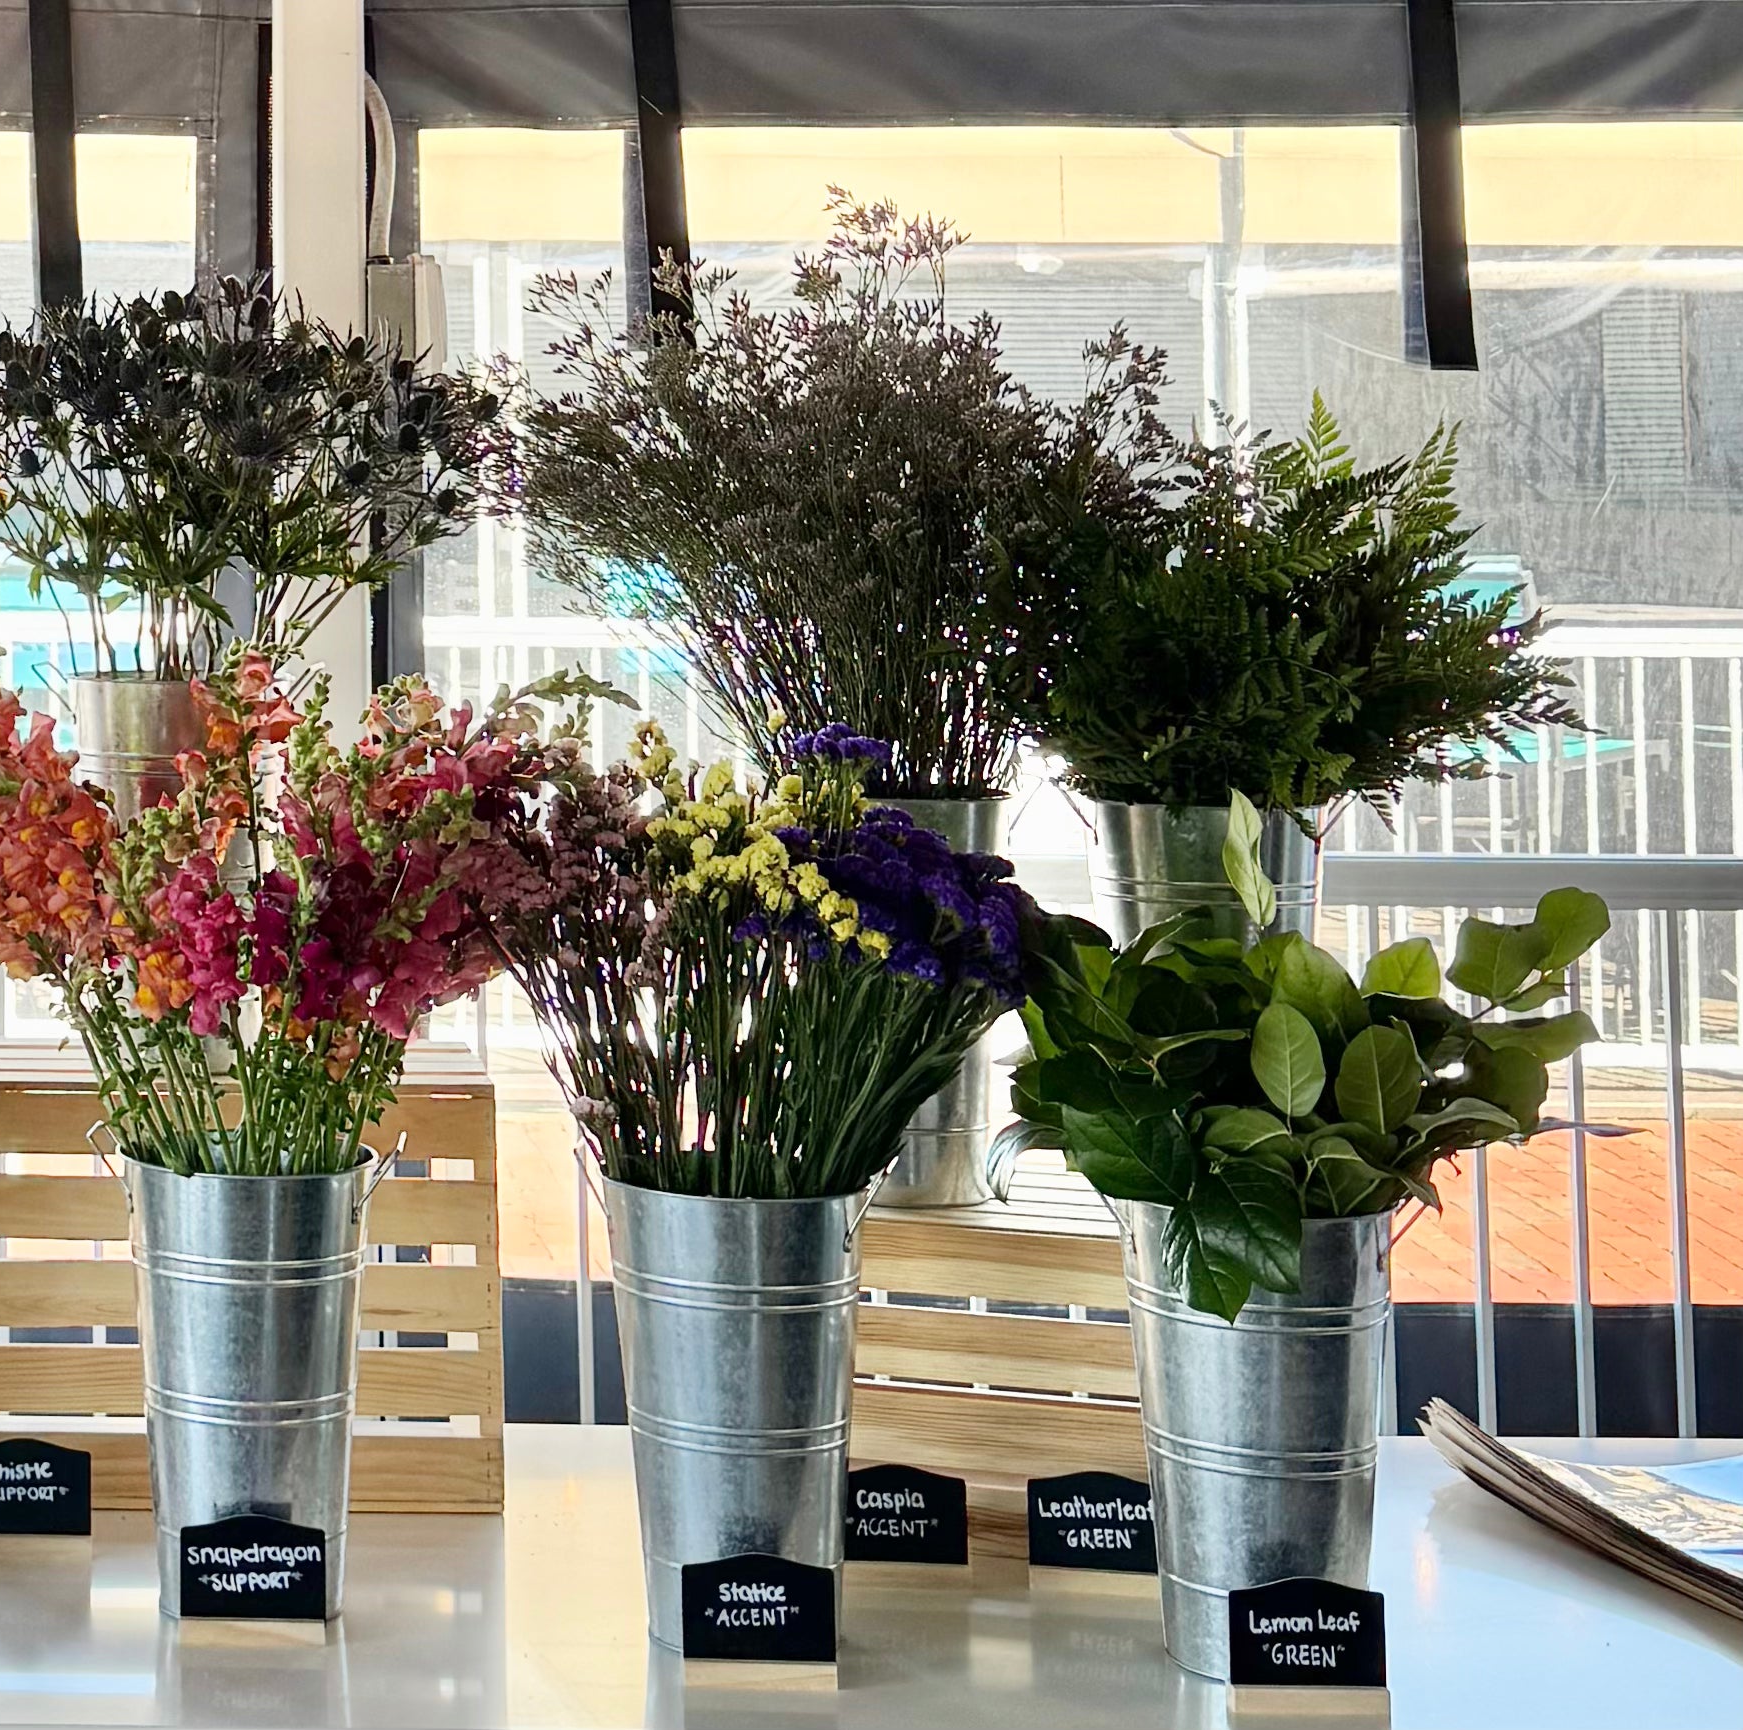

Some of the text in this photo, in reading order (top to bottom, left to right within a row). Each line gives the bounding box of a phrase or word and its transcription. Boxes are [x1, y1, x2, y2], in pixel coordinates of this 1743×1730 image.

[857, 1488, 925, 1514] Caspia
[188, 1543, 321, 1567] Snapdragon
[719, 1582, 786, 1603] Statice
[1249, 1609, 1360, 1634] Lemon Leaf
